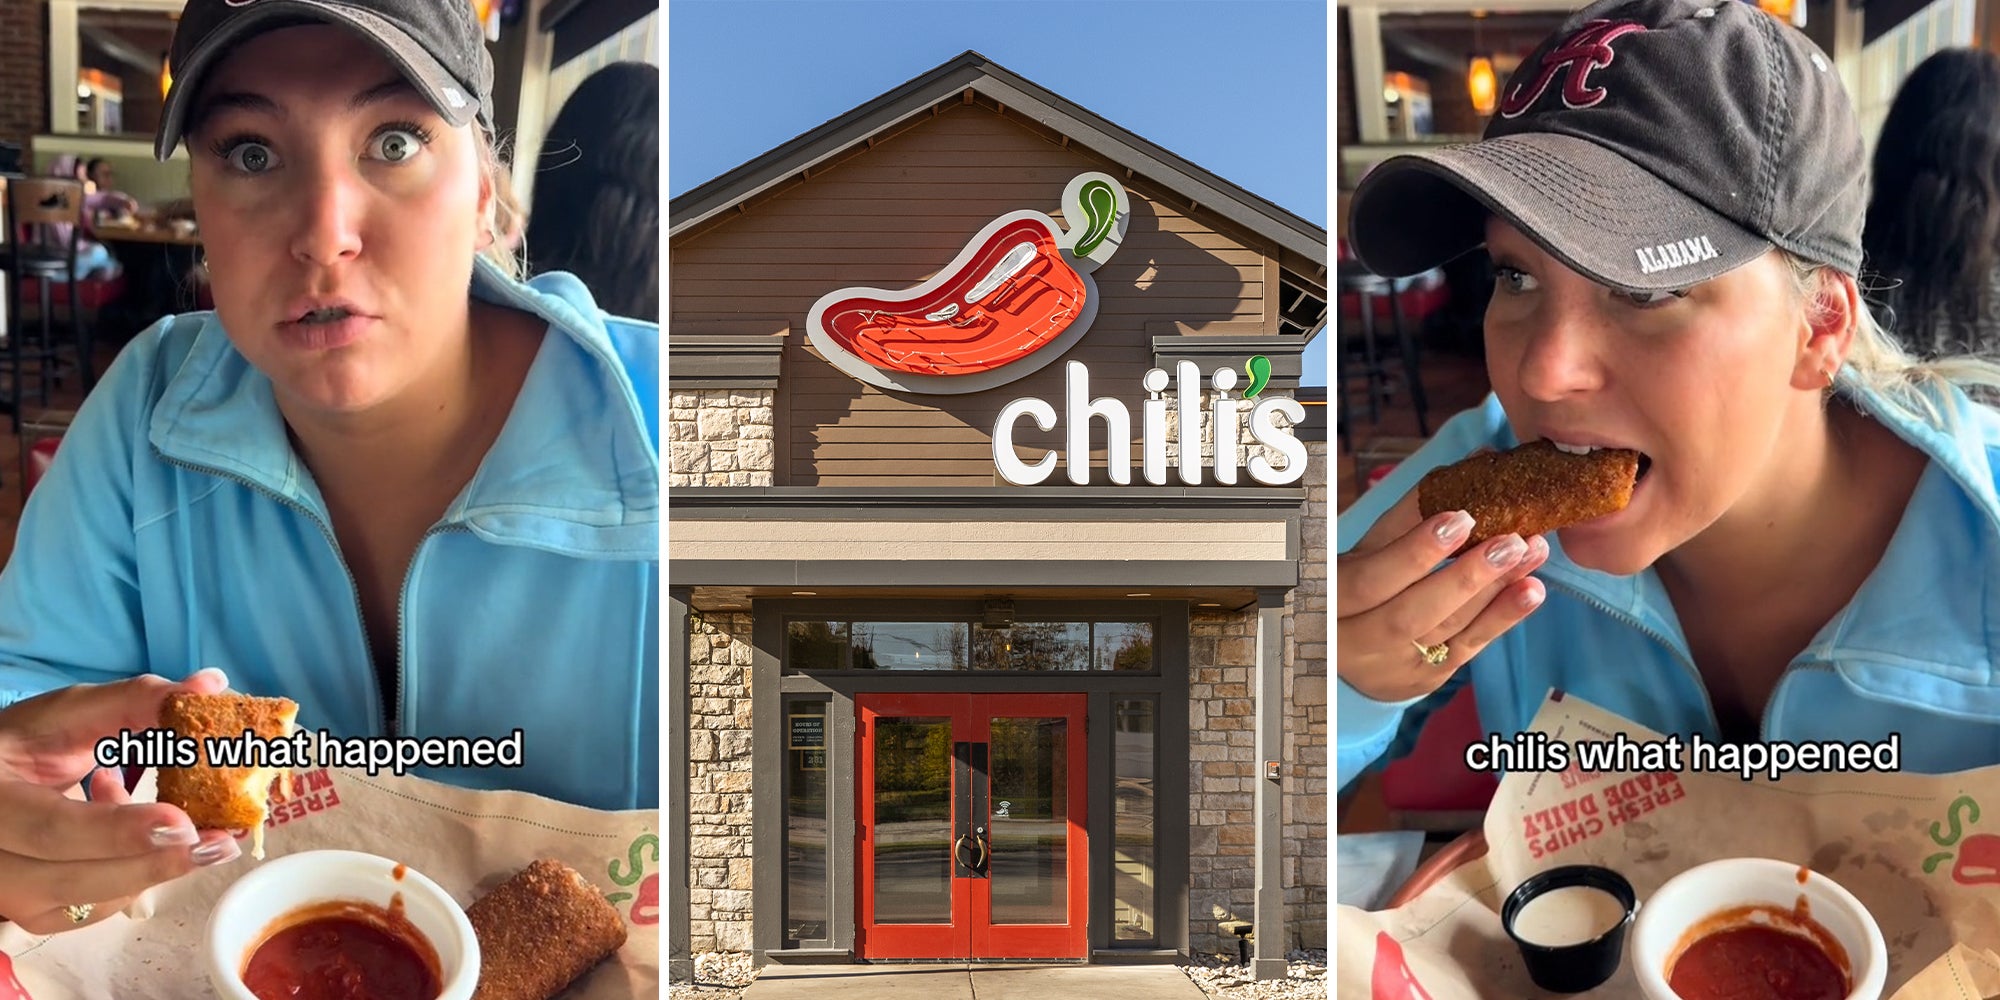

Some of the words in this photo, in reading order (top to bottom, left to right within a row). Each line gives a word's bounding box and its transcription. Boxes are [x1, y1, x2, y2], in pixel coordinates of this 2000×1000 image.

[1635, 235, 1719, 275] ALABAMA
[991, 354, 1307, 486] chili's
[1603, 772, 1679, 808] MADE
[1608, 782, 1685, 827] FRESH
[1523, 793, 1599, 838] DAILY
[1528, 817, 1605, 859] CHIPS
